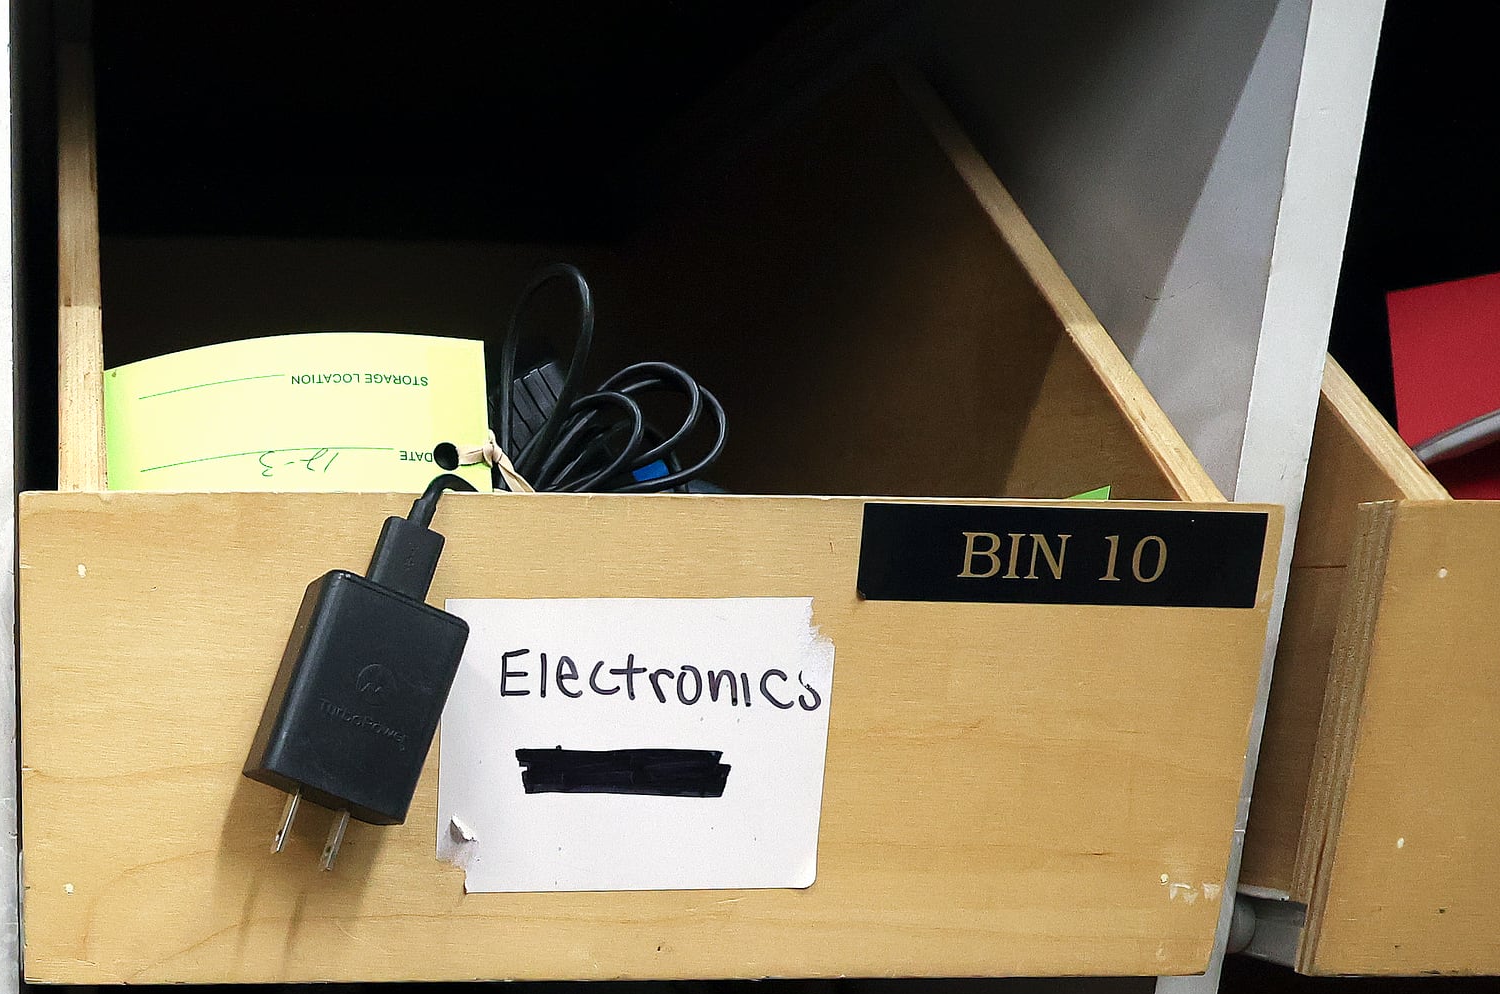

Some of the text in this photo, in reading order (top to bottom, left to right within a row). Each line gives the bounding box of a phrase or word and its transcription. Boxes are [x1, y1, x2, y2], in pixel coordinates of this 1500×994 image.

[291, 373, 429, 387] STORAGE LOCATION
[399, 450, 433, 463] DATE
[957, 531, 1170, 583] BIN 10
[500, 646, 823, 712] Electronics
